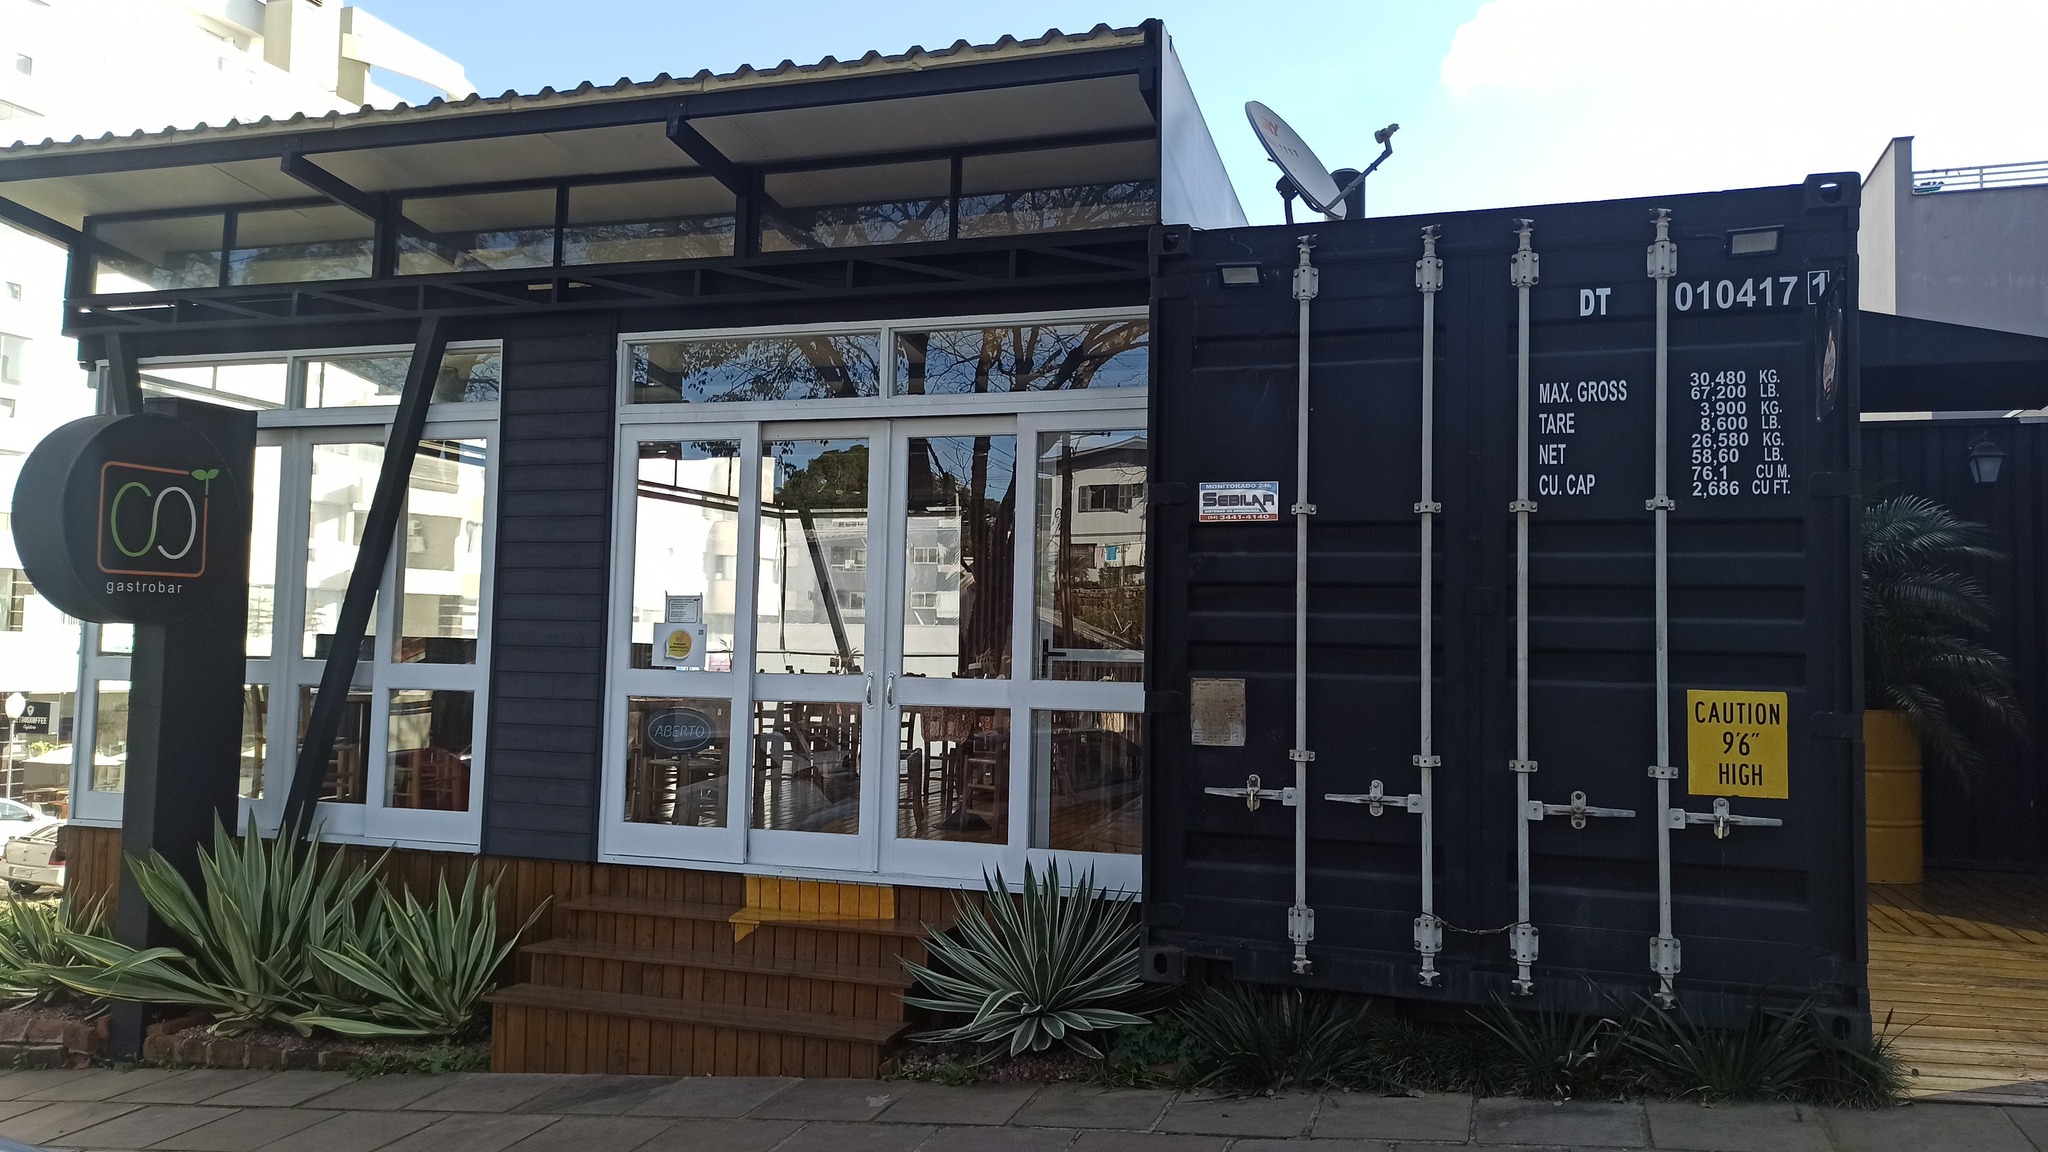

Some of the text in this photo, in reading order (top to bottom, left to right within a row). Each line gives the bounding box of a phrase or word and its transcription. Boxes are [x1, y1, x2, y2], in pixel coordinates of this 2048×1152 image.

[1579, 287, 1612, 317] DT
[1674, 275, 1799, 312] 010417
[1689, 369, 1780, 388] 30,480 KG.
[1538, 380, 1628, 404] MAX. GROSS
[1690, 383, 1780, 402] 67,200 LB.
[1700, 400, 1783, 418] 3,900 KG.
[1538, 413, 1576, 434] TARE
[1700, 415, 1781, 434] 8,600 LB.
[1691, 431, 1784, 450] 26,580 KG.
[1538, 444, 1567, 465] NET
[1691, 447, 1784, 466] 58,60 LB.
[1691, 463, 1791, 481] 76.1 CU M.
[1538, 474, 1596, 496] CU. CAP
[1692, 480, 1791, 499] 2,686 CU FT.
[106, 581, 182, 594] gastrobar
[1694, 701, 1780, 725] CAUTION
[654, 724, 705, 738] ABERTO
[1718, 763, 1763, 786] HIGH
